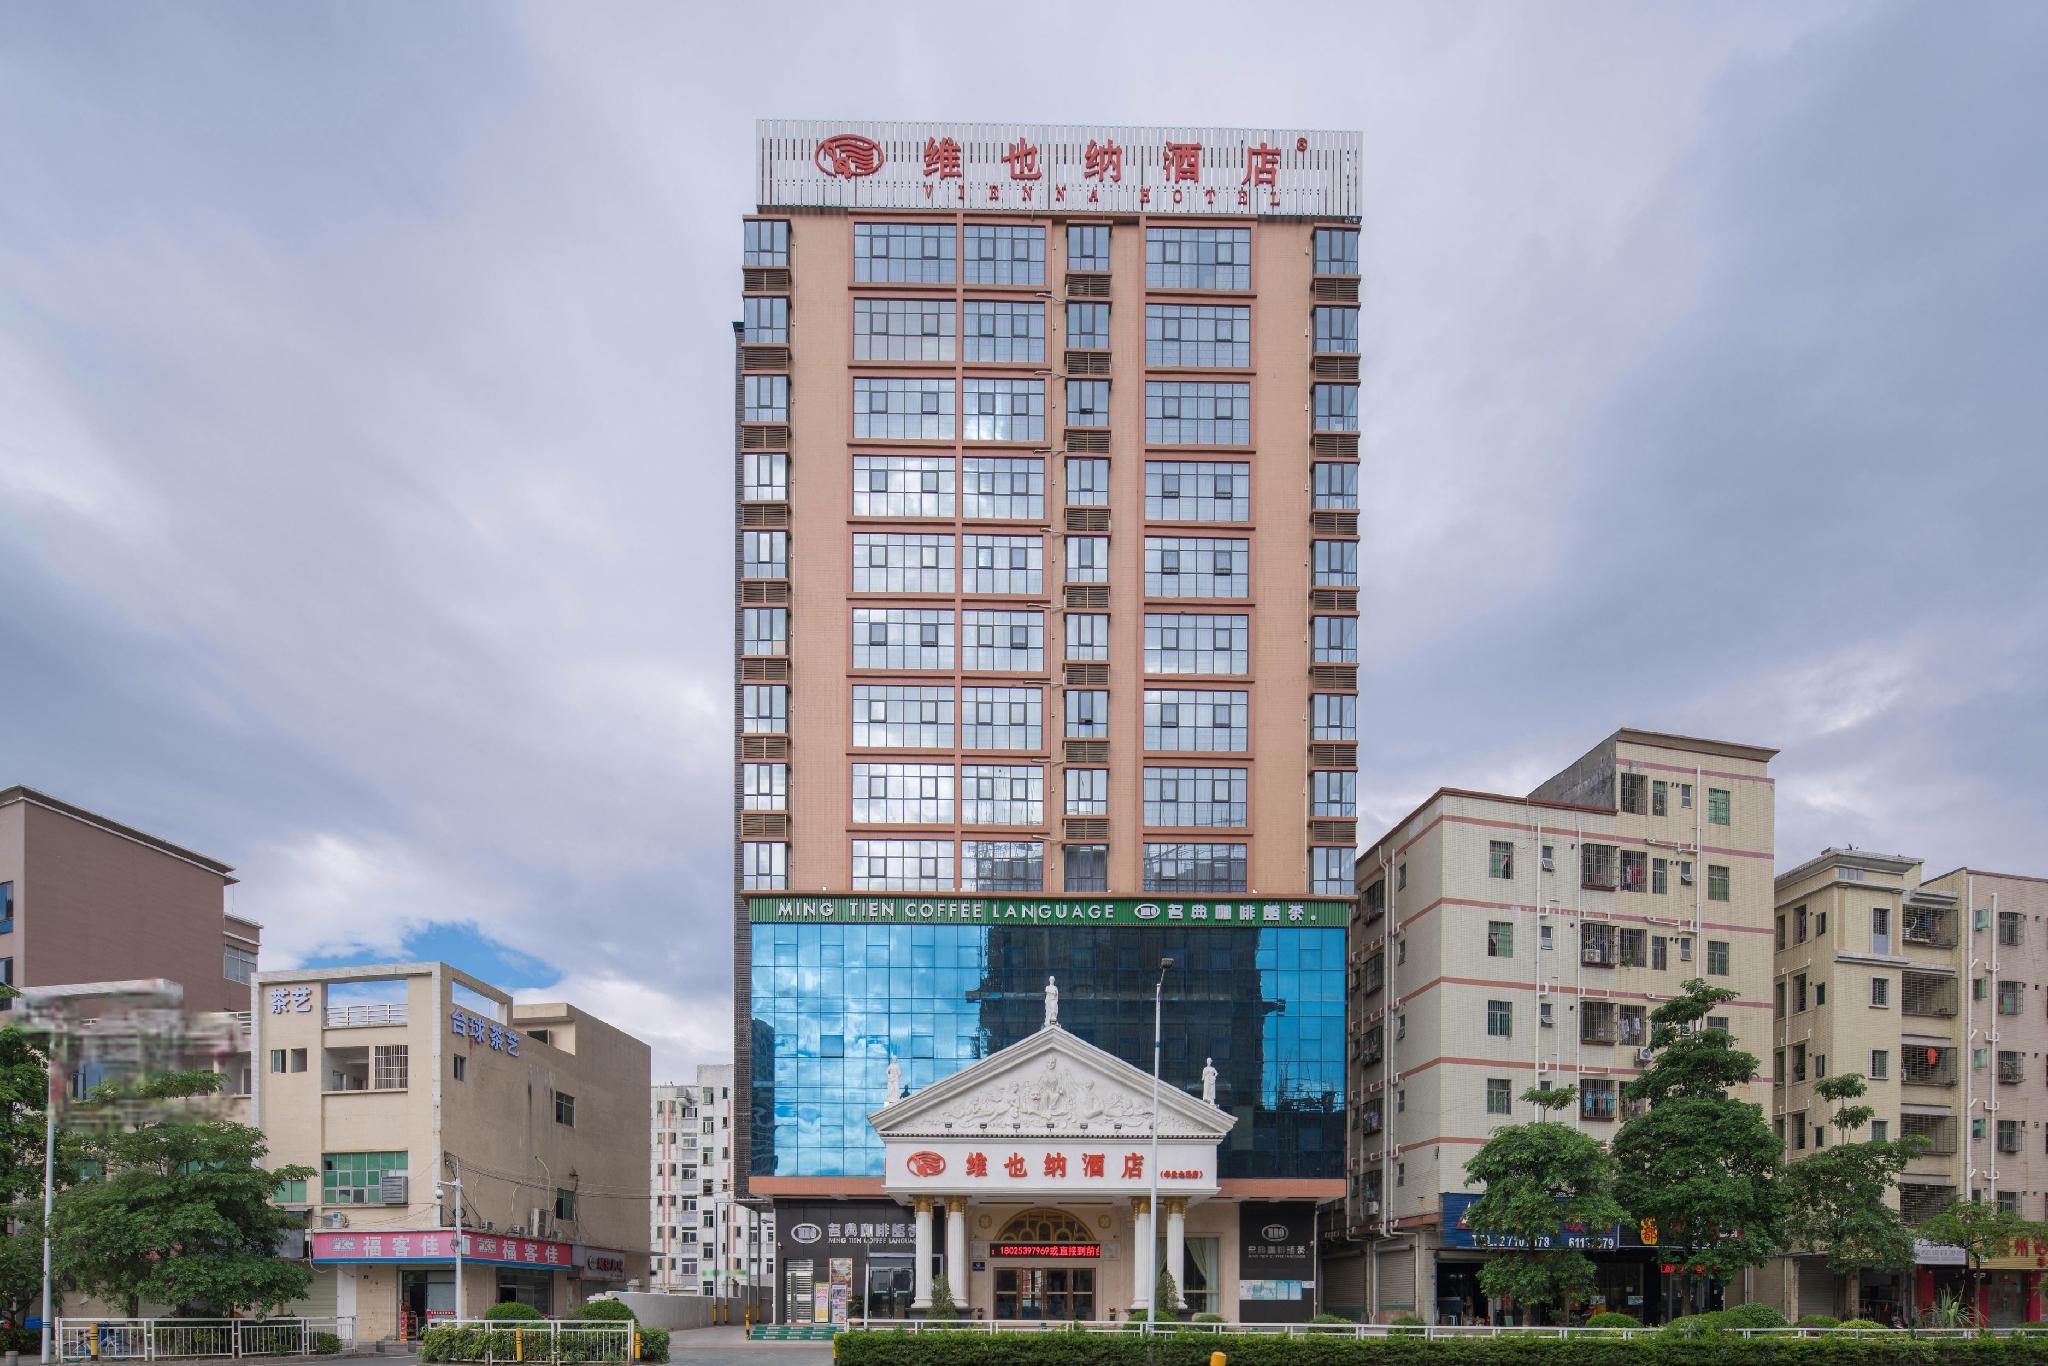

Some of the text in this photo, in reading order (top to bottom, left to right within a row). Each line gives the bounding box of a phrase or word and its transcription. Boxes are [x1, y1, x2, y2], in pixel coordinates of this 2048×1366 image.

[923, 136, 1280, 188] 维也纳酒店
[923, 184, 1281, 207] VIENNA HOTEL
[778, 902, 1114, 919] MING TIEN COFFEE LANGUAGE
[270, 987, 313, 1015] 茶艺
[965, 1151, 1145, 1179] 维也纳酒店
[363, 1236, 440, 1257] 福客佳
[502, 1239, 559, 1264] 福客佳
